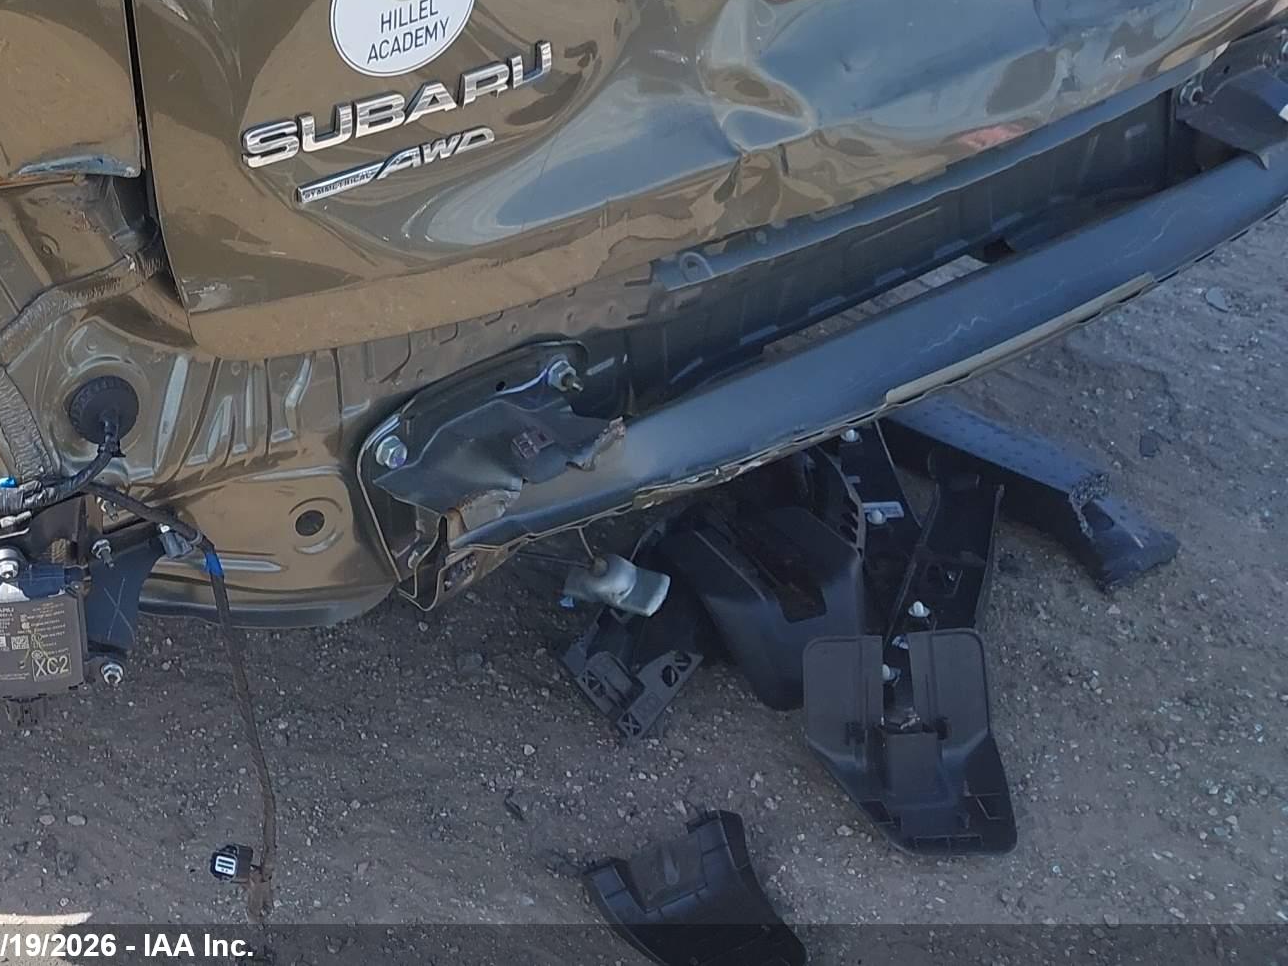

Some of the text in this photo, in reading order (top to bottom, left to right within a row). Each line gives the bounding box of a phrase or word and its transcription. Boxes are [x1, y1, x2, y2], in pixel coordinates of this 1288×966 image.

[367, 16, 450, 64] ACADEMY
[242, 39, 552, 168] SUBARU
[376, 128, 496, 180] AWD
[36, 656, 69, 677] XC2
